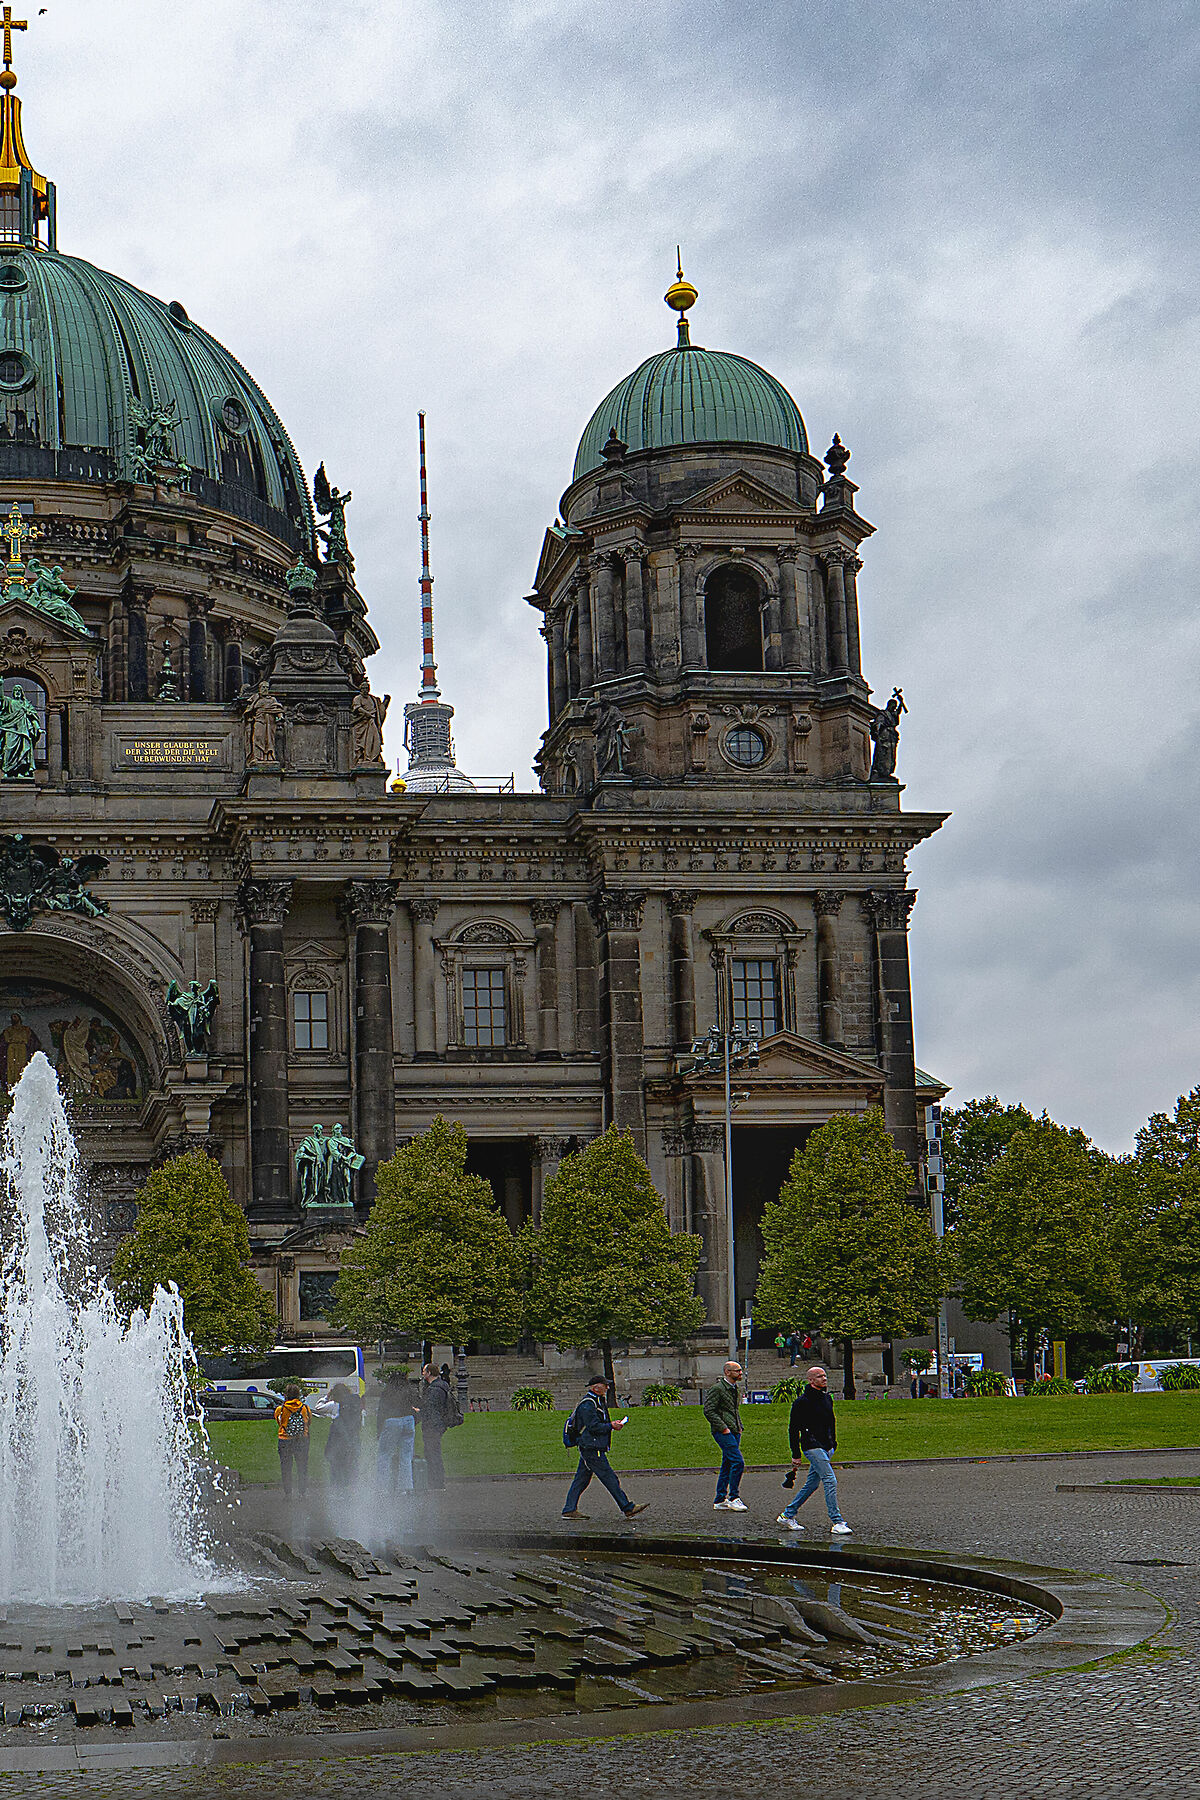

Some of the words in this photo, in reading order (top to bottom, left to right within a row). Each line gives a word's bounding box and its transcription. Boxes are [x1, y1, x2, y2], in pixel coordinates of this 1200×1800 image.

[125, 748, 141, 756] DER
[164, 748, 180, 756] DER
[183, 748, 196, 756] DIE
[198, 748, 219, 756] WELT
[133, 755, 192, 763] UEBERWUNDEN
